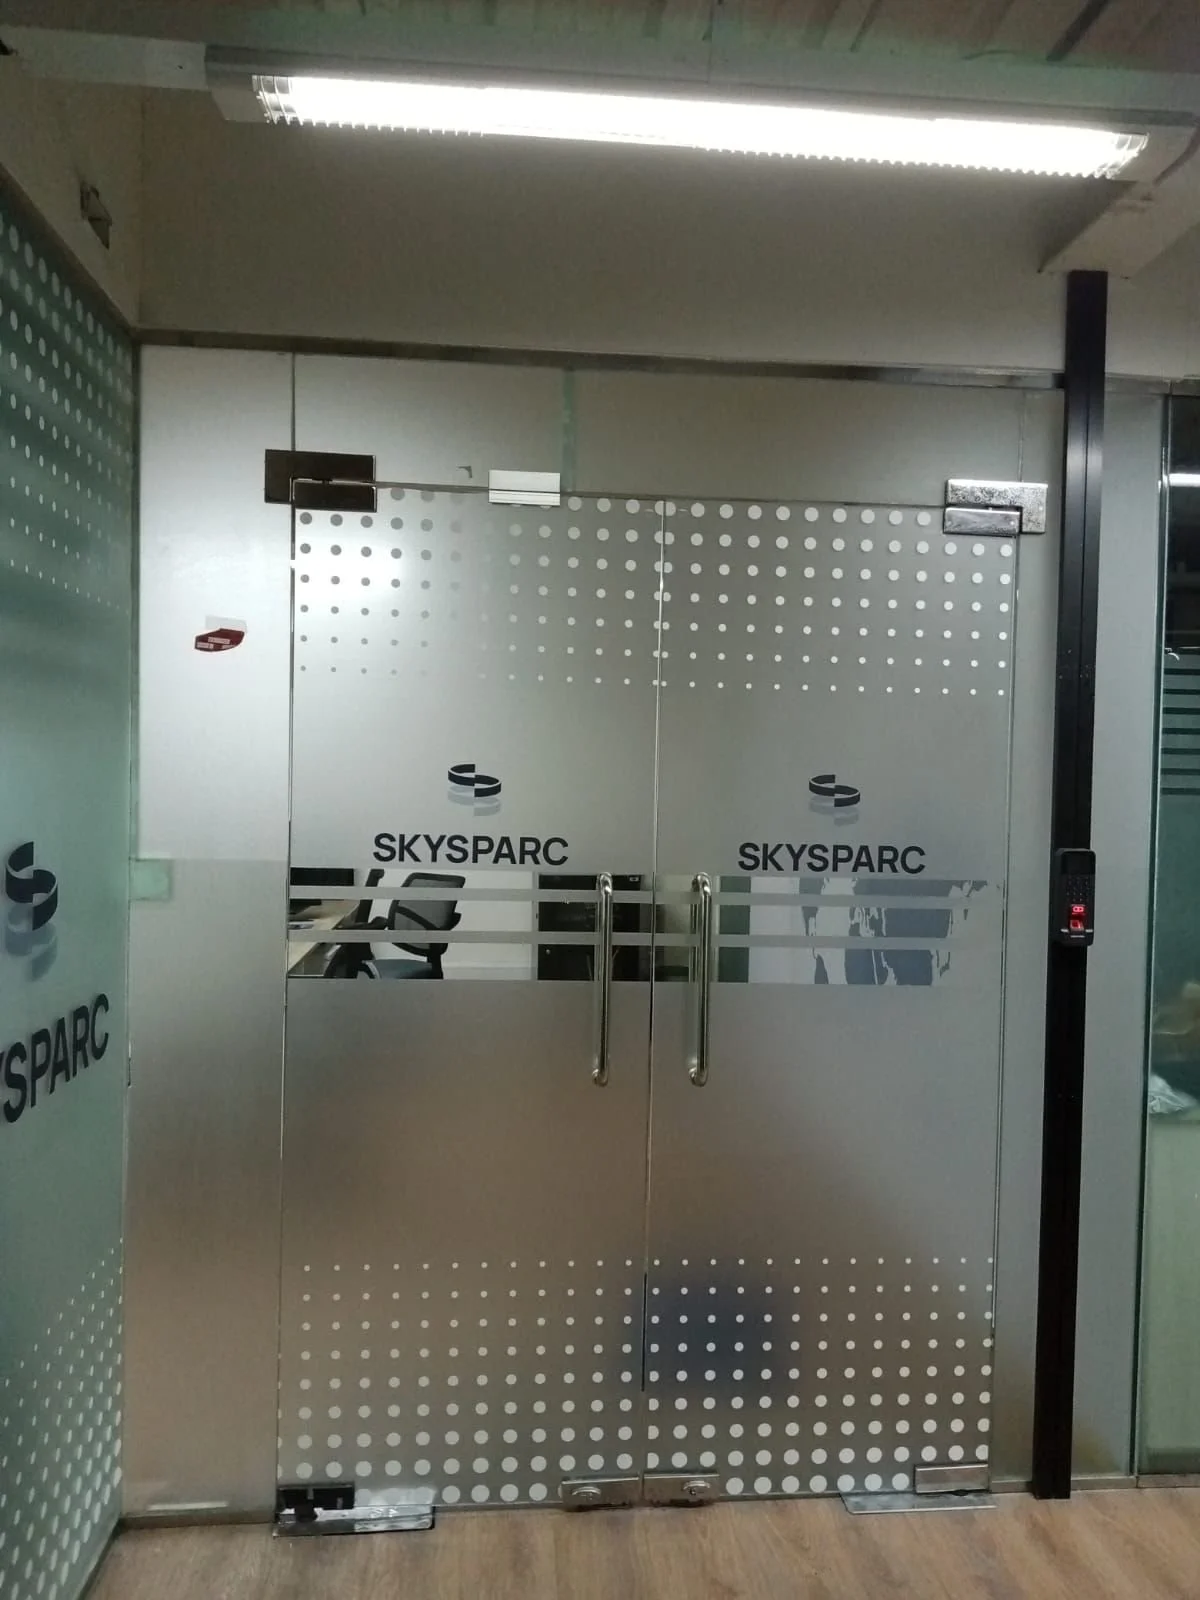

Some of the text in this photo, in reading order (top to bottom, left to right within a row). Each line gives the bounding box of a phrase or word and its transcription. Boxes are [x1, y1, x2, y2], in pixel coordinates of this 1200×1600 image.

[372, 832, 569, 866] SKYSPARC
[738, 842, 926, 875] SKYSPARC
[0, 993, 109, 1123] SPARC
